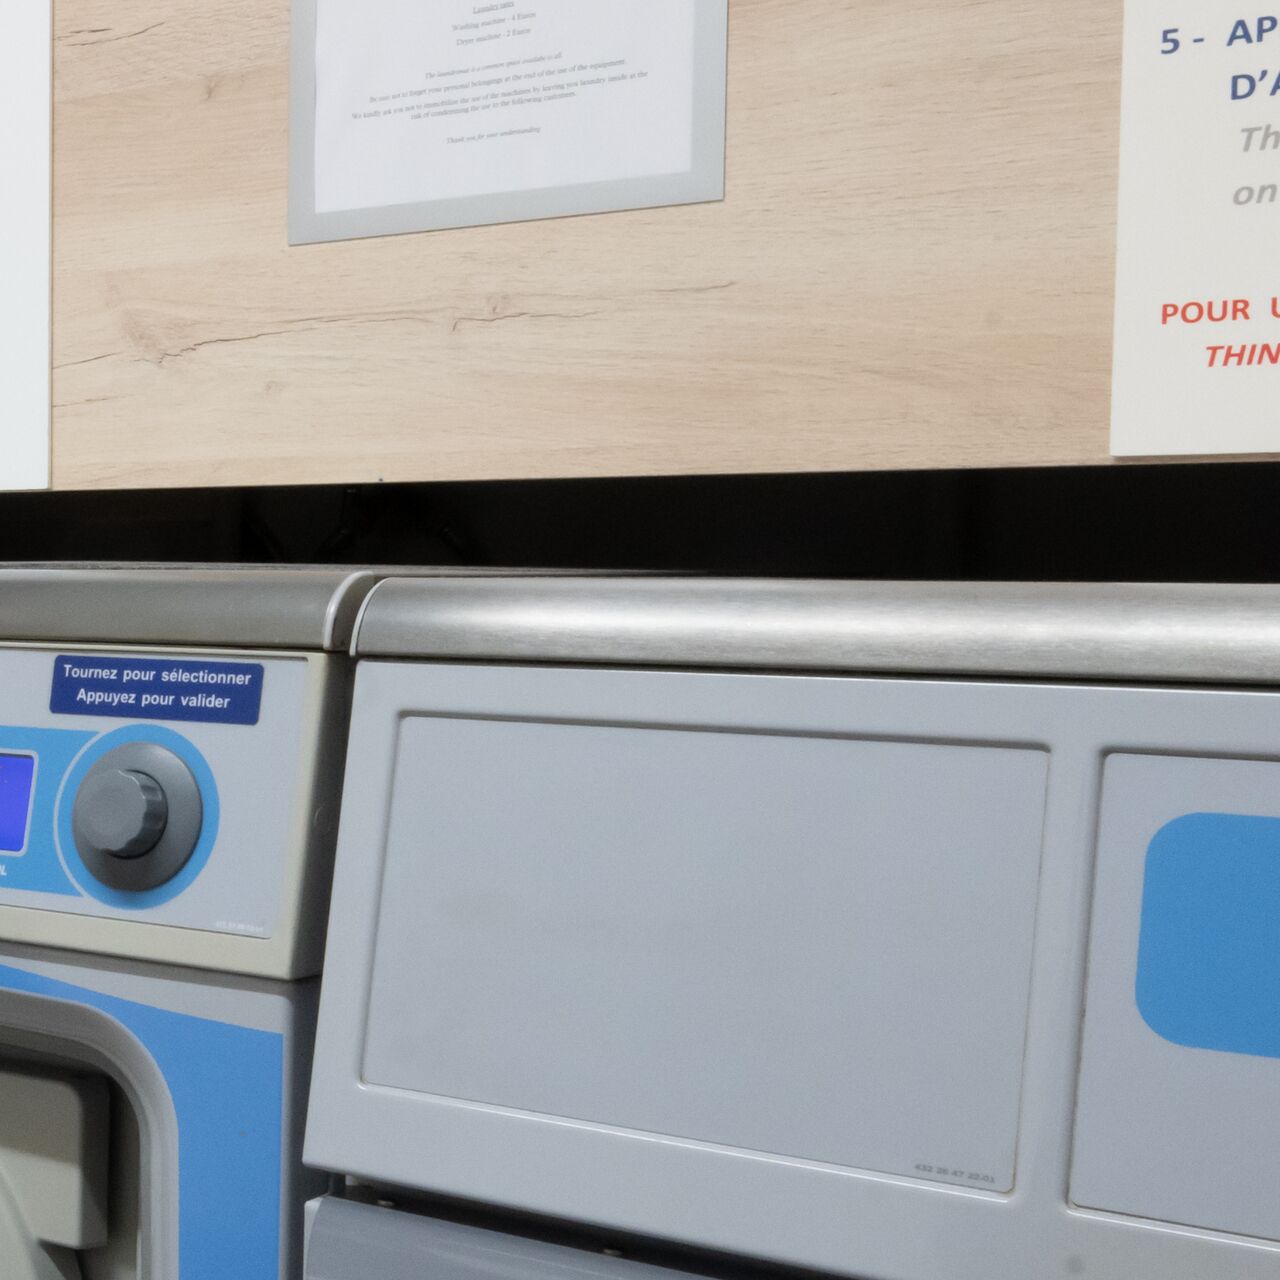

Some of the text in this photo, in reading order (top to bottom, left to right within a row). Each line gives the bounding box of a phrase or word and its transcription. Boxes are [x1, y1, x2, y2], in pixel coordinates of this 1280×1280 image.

[1161, 28, 1180, 54] 5
[1233, 183, 1278, 206] on
[1161, 298, 1250, 325] POUR
[63, 664, 251, 685] Tournez pour sélectionner
[76, 688, 230, 708] Appuyez pour valider
